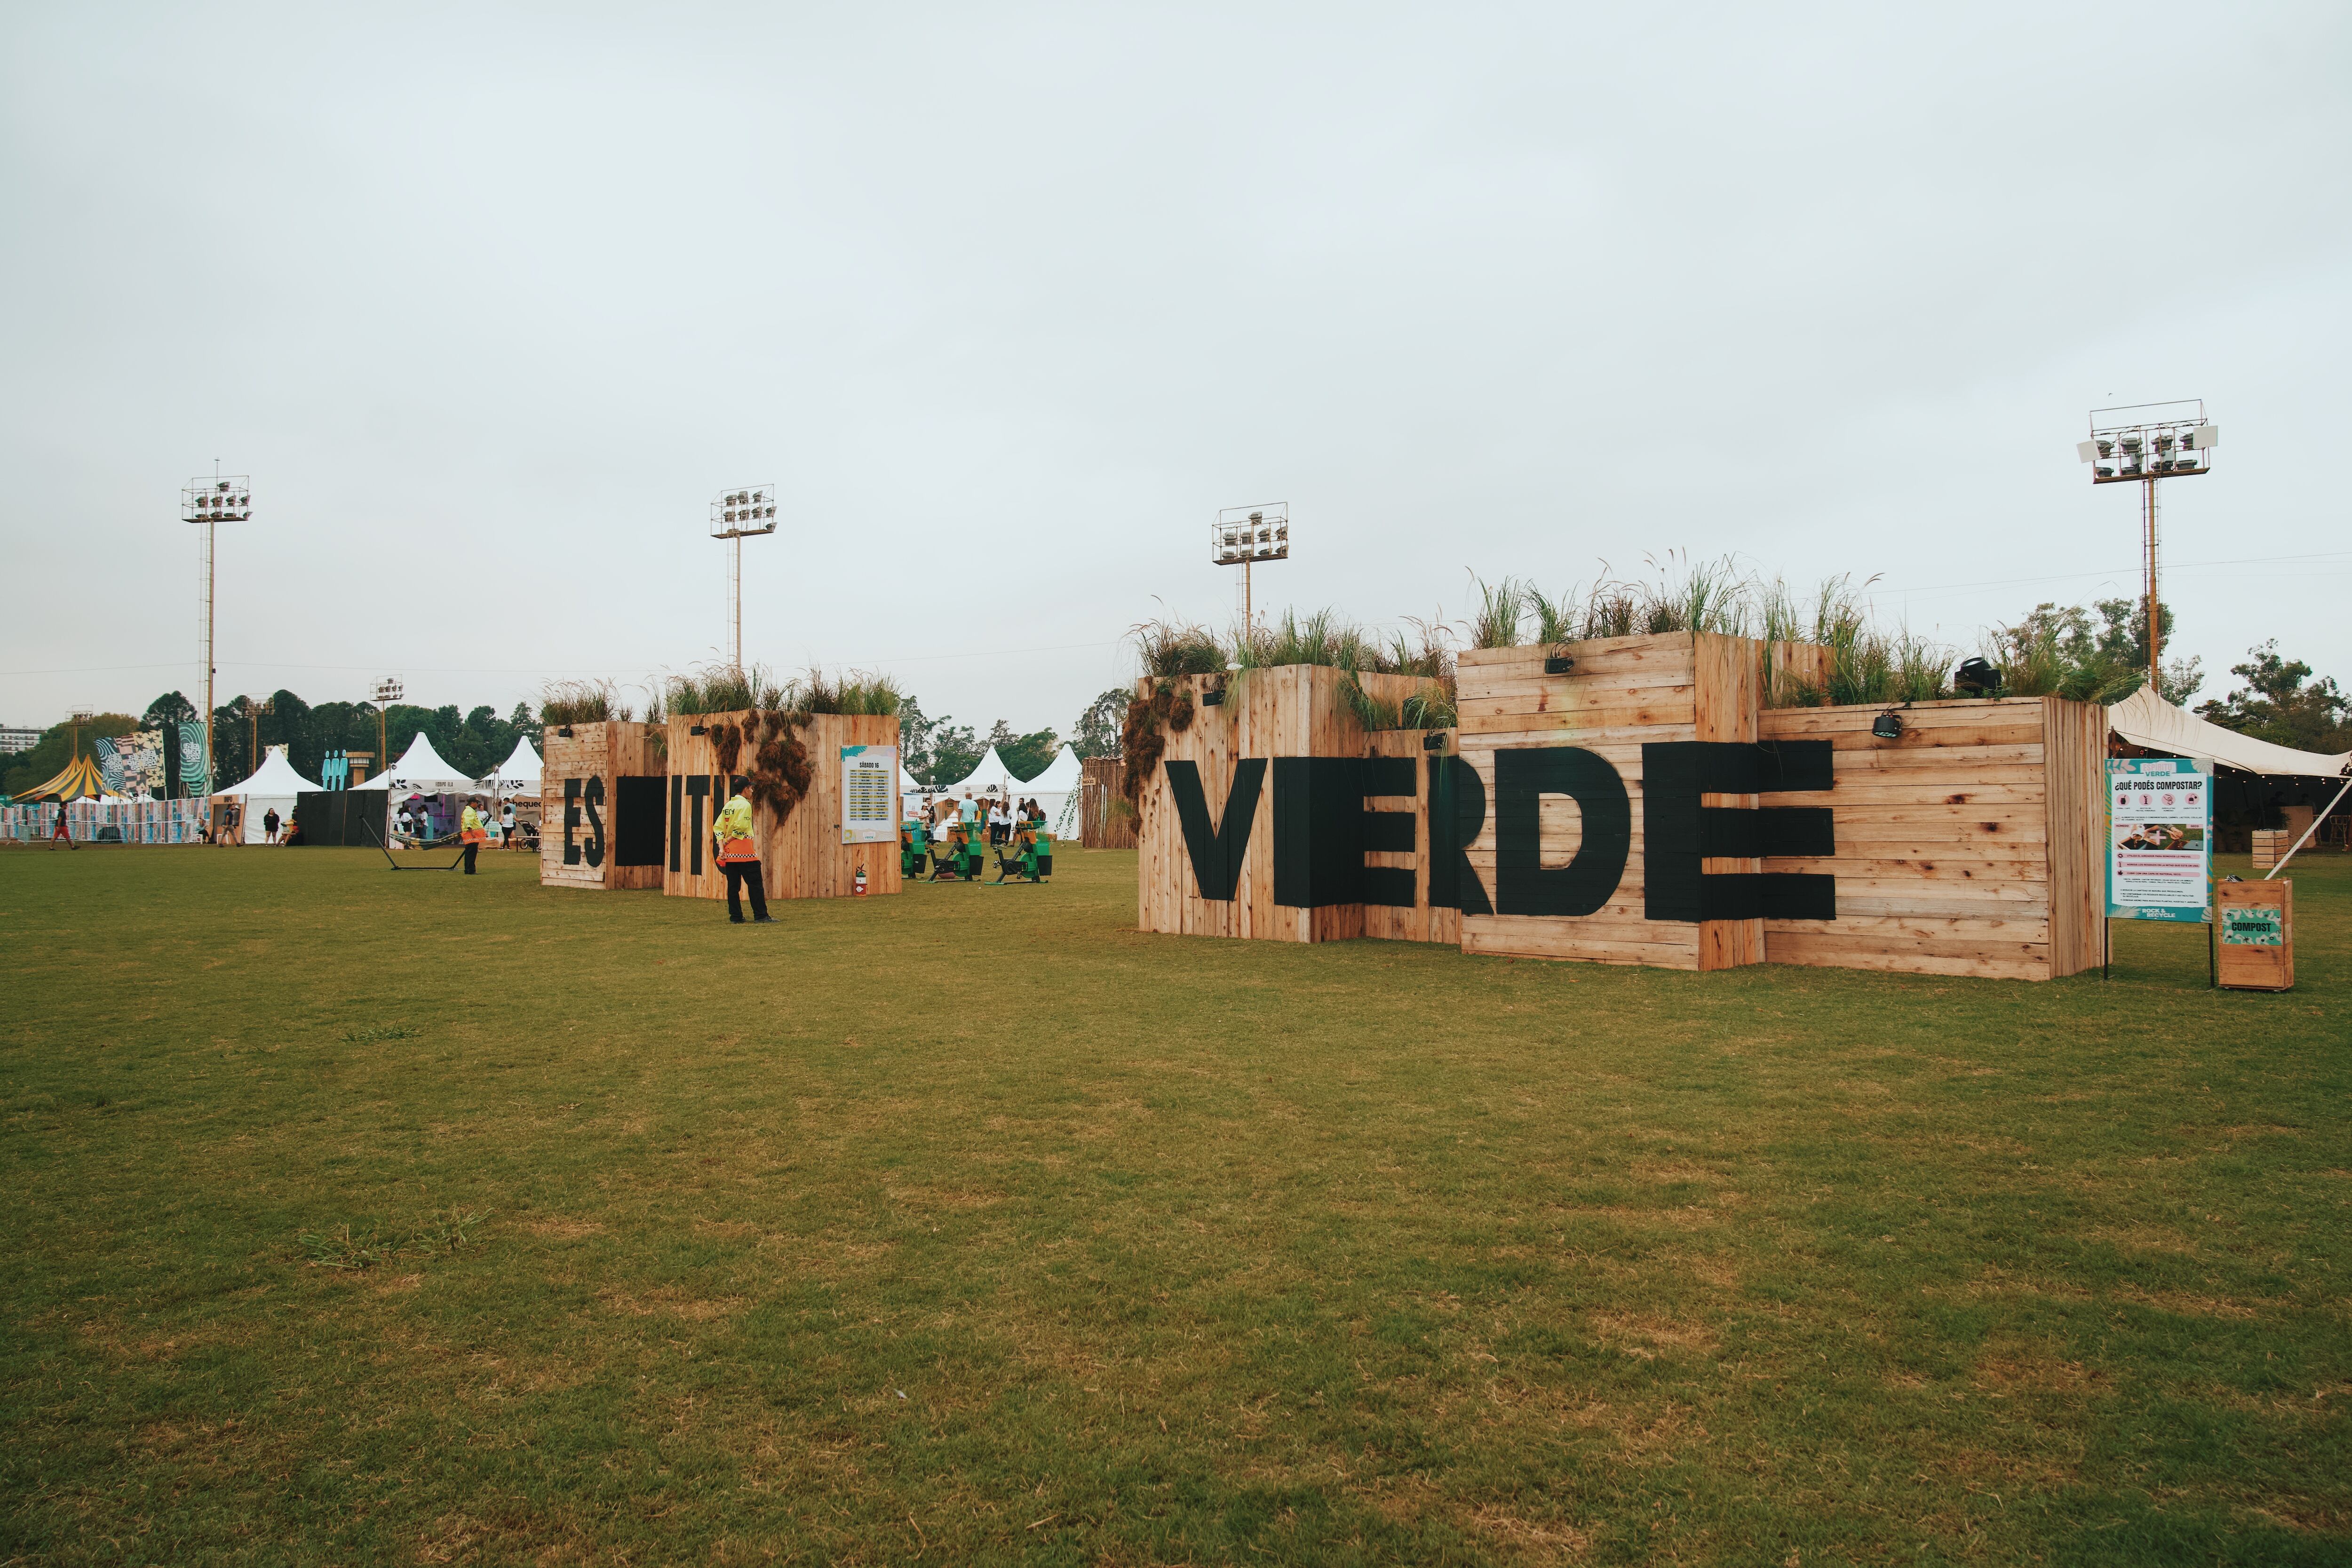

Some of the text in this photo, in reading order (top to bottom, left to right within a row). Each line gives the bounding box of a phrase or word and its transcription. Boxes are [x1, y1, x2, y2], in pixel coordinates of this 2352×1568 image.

[2115, 780, 2202, 790] ¿QUÉ PODÉS COMPOSTAR?
[1164, 740, 1836, 923] VERDE
[2232, 922, 2271, 932] COMPOST
